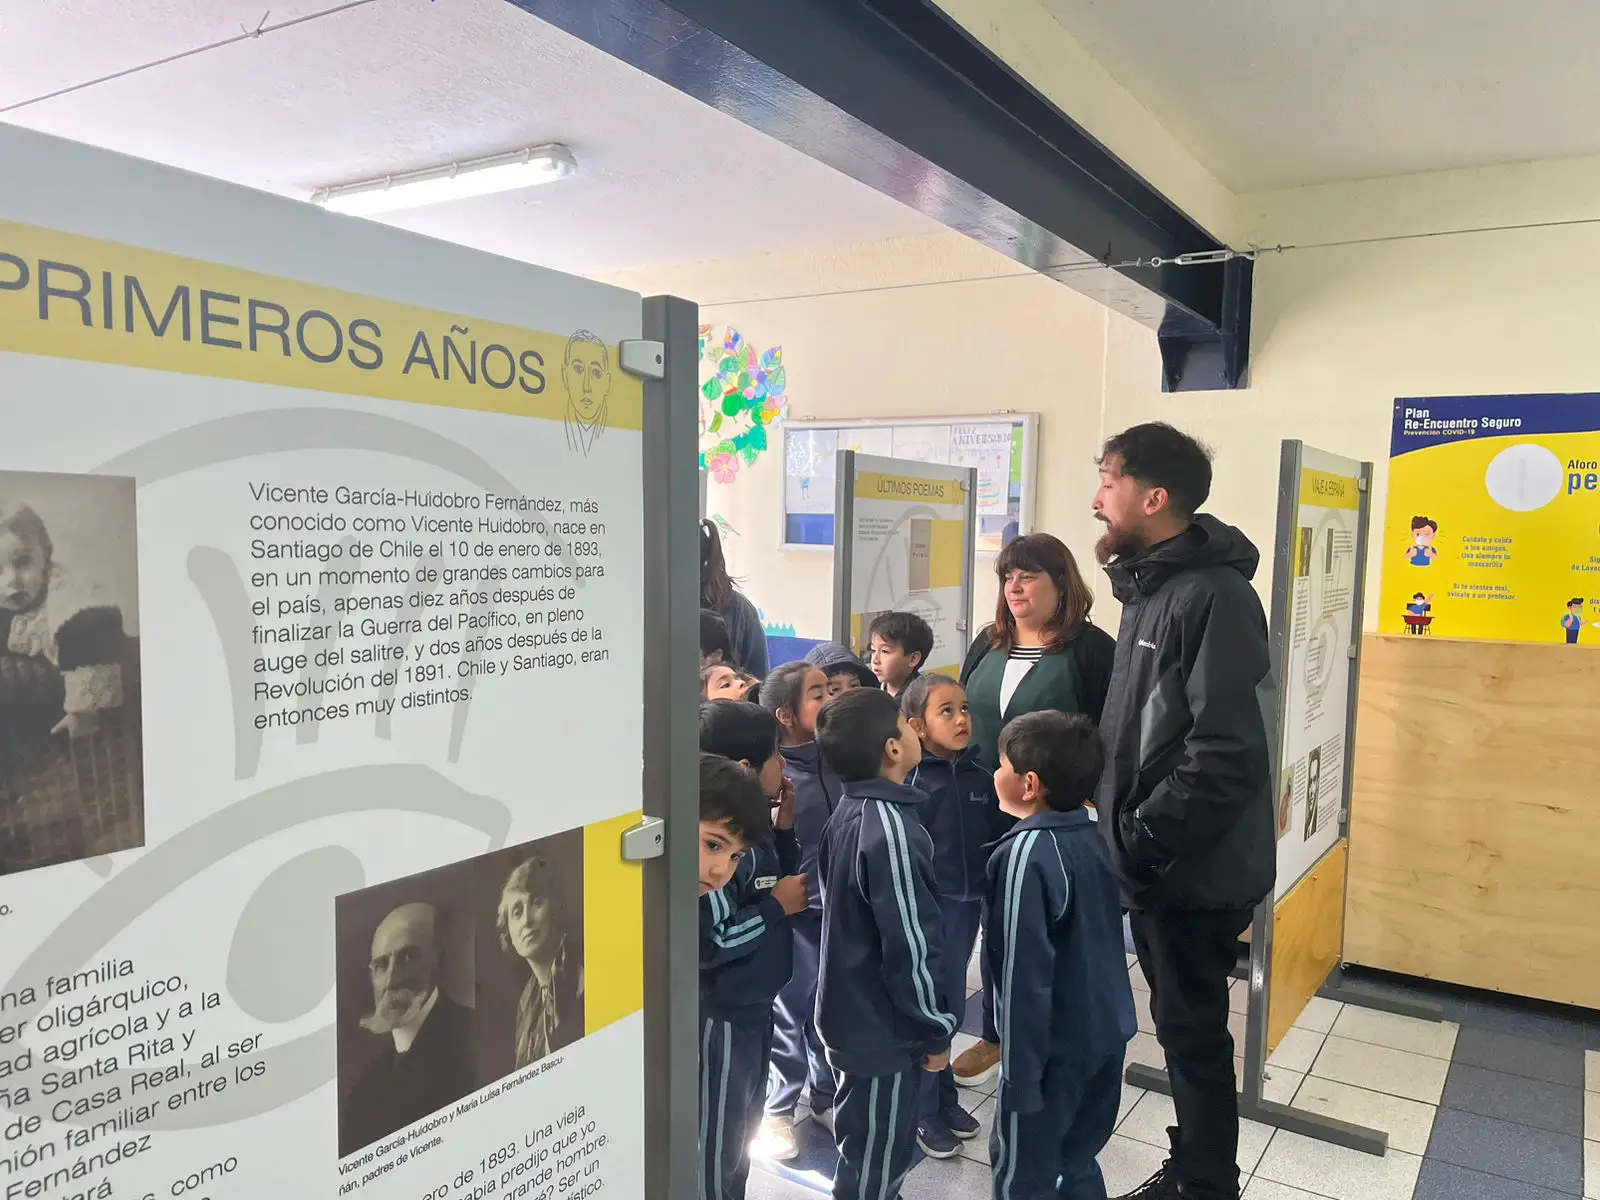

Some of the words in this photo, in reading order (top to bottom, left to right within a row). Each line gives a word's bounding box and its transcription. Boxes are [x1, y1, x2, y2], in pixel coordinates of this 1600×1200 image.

[402, 325, 547, 395] AÑOS
[1404, 418, 1478, 430] Re-Encuentro
[1481, 417, 1522, 430] Seguro
[1405, 408, 1430, 418] Plan
[1568, 460, 1597, 469] Aforo
[249, 482, 328, 504] Vicente
[335, 487, 481, 510] García-Huidobro
[486, 494, 565, 514] Fernández,
[570, 498, 599, 514] más
[877, 476, 912, 494] ÚLTIMOS
[914, 483, 944, 497] POEMAS
[250, 513, 346, 531] conocido
[352, 516, 406, 532] como
[412, 516, 472, 533] Vicente
[478, 518, 549, 536] Huidobro,
[554, 522, 586, 534] nace
[590, 524, 605, 535] en
[251, 539, 342, 562] Santiago
[349, 540, 374, 558] de
[379, 541, 423, 558] Chile
[429, 541, 443, 557] el
[449, 541, 469, 557] 10
[474, 541, 493, 556] de
[499, 544, 539, 556] enero
[544, 541, 561, 556] de
[567, 541, 602, 558] 1893,
[251, 571, 278, 587] en
[286, 569, 312, 586] un
[319, 565, 410, 585] momento
[416, 566, 437, 582] de
[443, 564, 508, 589] grandes
[512, 563, 572, 580] cambios
[576, 564, 604, 584] para
[252, 596, 271, 615] el
[278, 594, 326, 618] país,
[334, 594, 404, 615] apenas
[409, 591, 444, 607] diez
[449, 589, 488, 605] años
[492, 587, 554, 608] después
[558, 586, 576, 600] de
[252, 622, 332, 644] finalizar
[339, 620, 354, 638] la
[361, 616, 422, 638] Guerra
[428, 615, 453, 632] del
[458, 611, 521, 631] Pacífico,
[526, 612, 542, 624] en
[548, 608, 584, 627] pleno
[253, 651, 307, 674] auge
[314, 648, 343, 667] del
[351, 643, 408, 664] salitre,
[414, 646, 424, 661] y
[430, 639, 460, 656] dos
[465, 636, 502, 652] años
[508, 629, 568, 652] después
[571, 628, 588, 642] de
[591, 627, 602, 641] la
[254, 673, 364, 701] Revolución
[371, 668, 398, 688] del
[405, 662, 451, 684] 1891.
[458, 660, 496, 678] Chile
[500, 659, 509, 676] y
[513, 653, 577, 676] Santiago,
[581, 648, 609, 662] eran
[254, 702, 349, 729] entonces
[356, 698, 395, 716] muy
[401, 688, 472, 710] distintos.
[46, 958, 135, 998] familia
[36, 975, 188, 1033] oligárquico,
[42, 1015, 148, 1064] agrícola
[156, 1008, 170, 1030] y
[178, 1001, 193, 1019] a
[201, 991, 220, 1010] la
[41, 1055, 118, 1097] Santa
[128, 1035, 174, 1066] Rita
[182, 1029, 196, 1051] y
[4, 1113, 42, 1141] de
[51, 1083, 122, 1124] Casa
[131, 1058, 192, 1096] Real,
[200, 1045, 220, 1069] al
[227, 1031, 263, 1058] ser
[64, 1100, 160, 1150] familiar
[167, 1074, 228, 1110] entre
[235, 1059, 266, 1085] los
[338, 1152, 374, 1177] Vicente
[376, 1114, 448, 1157] García-Huidobro
[448, 1112, 456, 1122] y
[456, 1098, 479, 1116] María
[480, 1088, 500, 1106] Luisa
[501, 1068, 540, 1094] Fernández
[541, 1056, 565, 1075] Bascu-
[6, 1133, 152, 1200] Fernández
[338, 1180, 360, 1197] ñán,
[361, 1161, 396, 1186] padres
[396, 1153, 409, 1167] de
[410, 1136, 444, 1158] Vicente.
[453, 1169, 474, 1190] de
[480, 1144, 520, 1174] 1893.
[524, 1126, 553, 1148] Una
[556, 1104, 586, 1130] vieja
[500, 1146, 549, 1189] predijo
[552, 1131, 578, 1159] que
[580, 1119, 596, 1140] yo
[556, 1134, 610, 1171] hombre.
[171, 1156, 238, 1197] como
[558, 1170, 582, 1194] Ser
[584, 1158, 600, 1180] un
